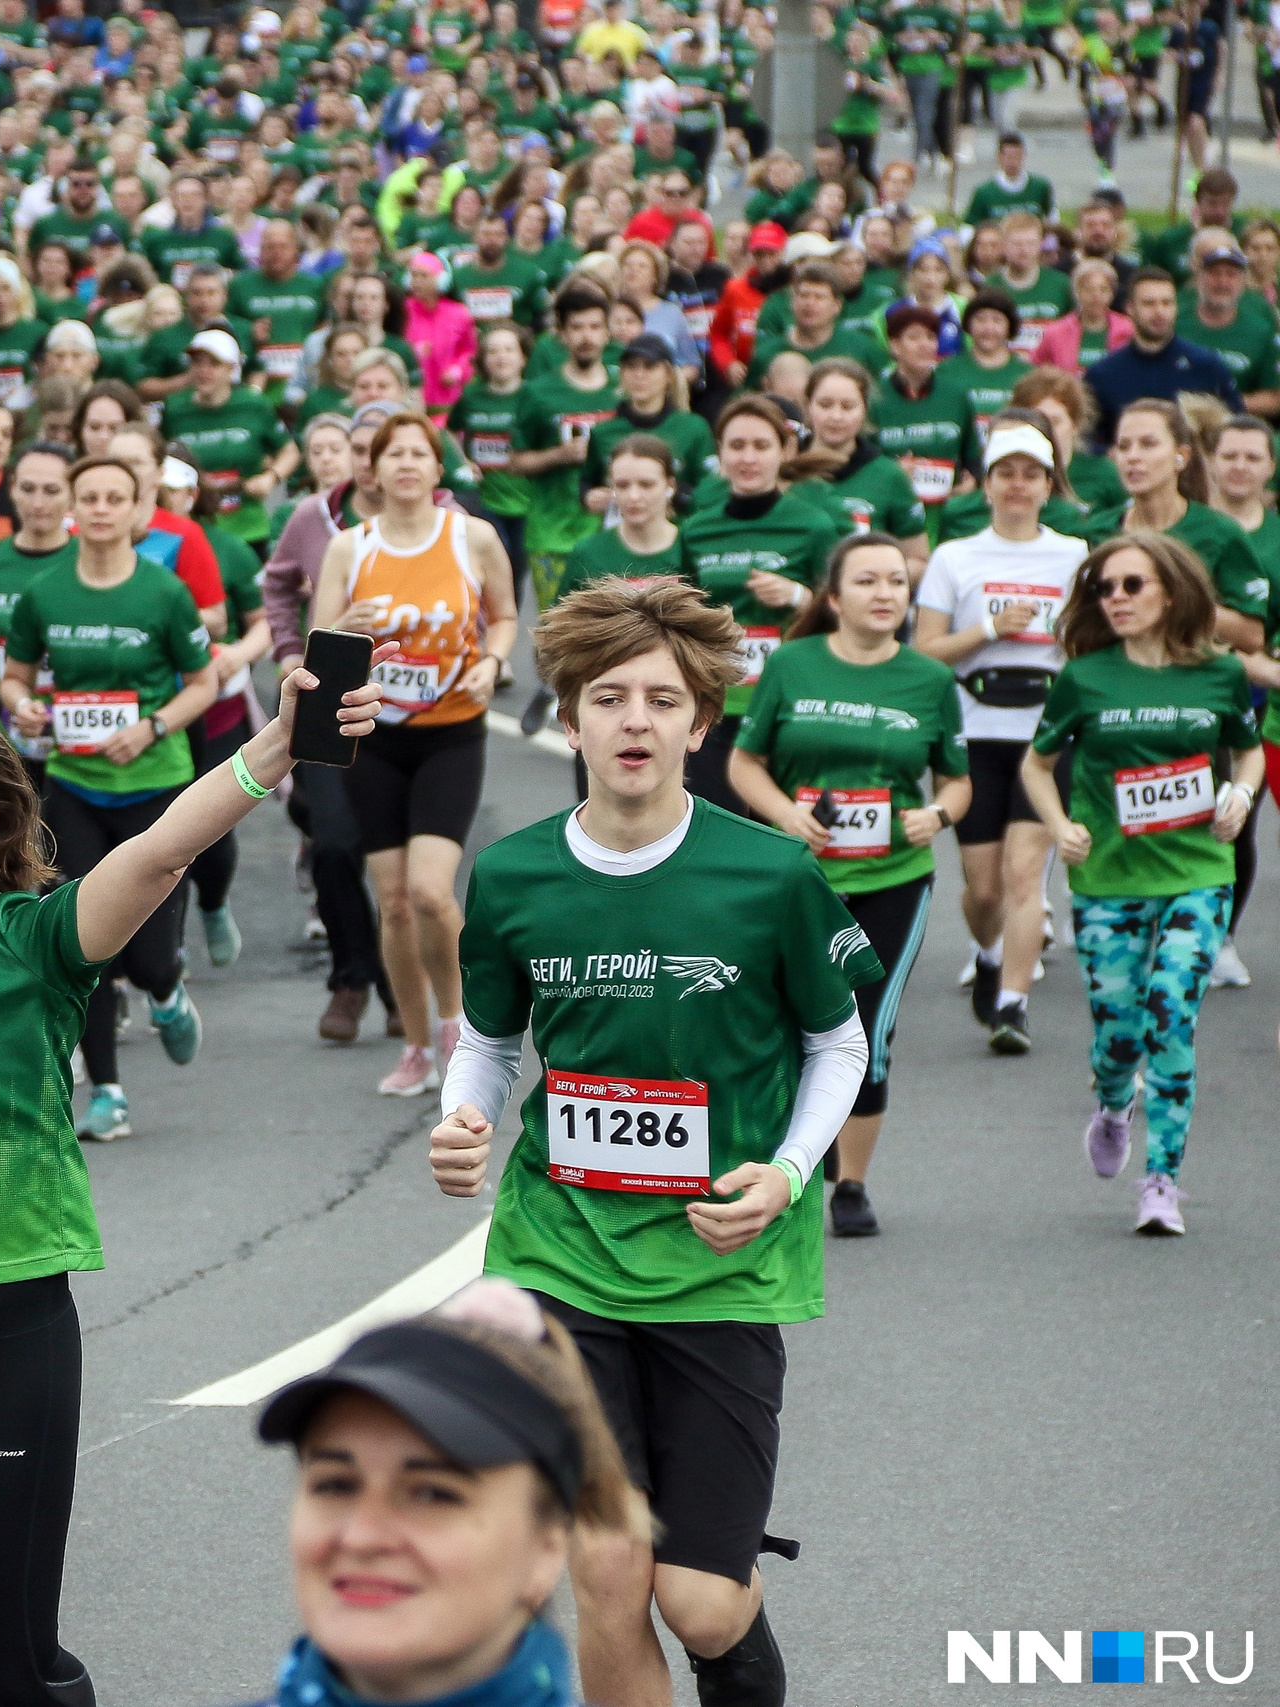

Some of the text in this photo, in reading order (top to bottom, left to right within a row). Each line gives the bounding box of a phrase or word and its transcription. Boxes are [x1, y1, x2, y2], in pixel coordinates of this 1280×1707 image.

[61, 708, 127, 728] 10586
[1126, 775, 1202, 808] 10451
[530, 949, 658, 985] БЕГИ, ГЕРОЙ!
[571, 984, 627, 999] НОВГОРОД
[628, 985, 655, 998] 2023
[555, 1080, 578, 1093] БЕГИ,
[579, 1083, 607, 1096] ГЕРОЙ!
[559, 1104, 690, 1149] 11286
